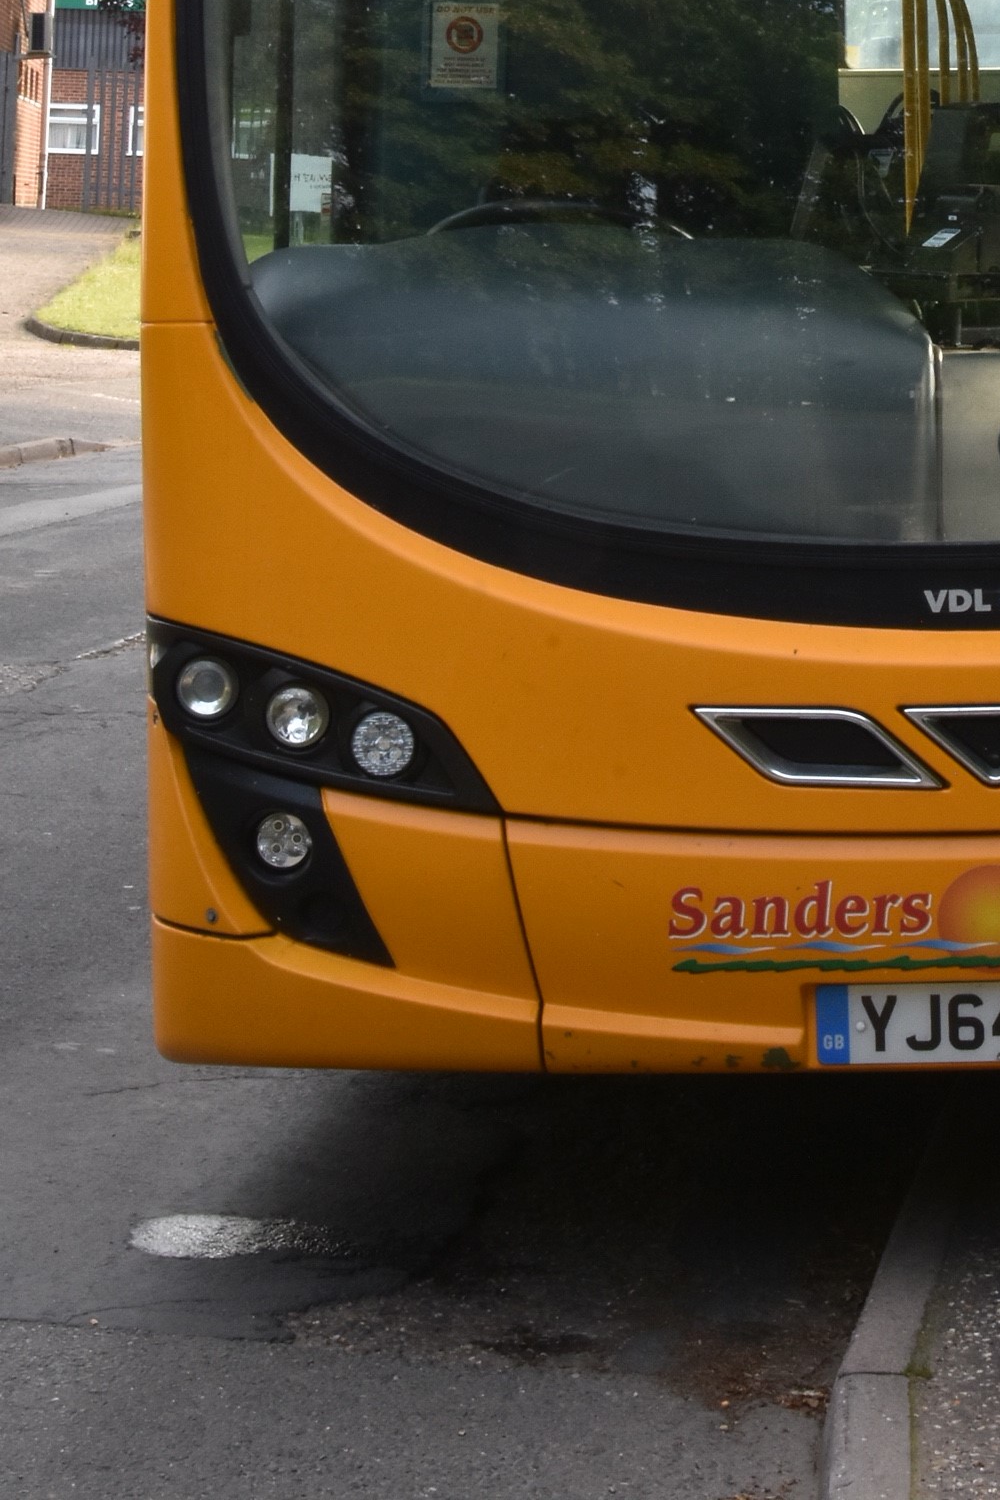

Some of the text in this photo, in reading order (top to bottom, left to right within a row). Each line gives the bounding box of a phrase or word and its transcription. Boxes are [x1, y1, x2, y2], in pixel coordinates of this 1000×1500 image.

[924, 588, 992, 613] VDL
[668, 880, 933, 939] Sanders
[822, 1033, 845, 1050] GB
